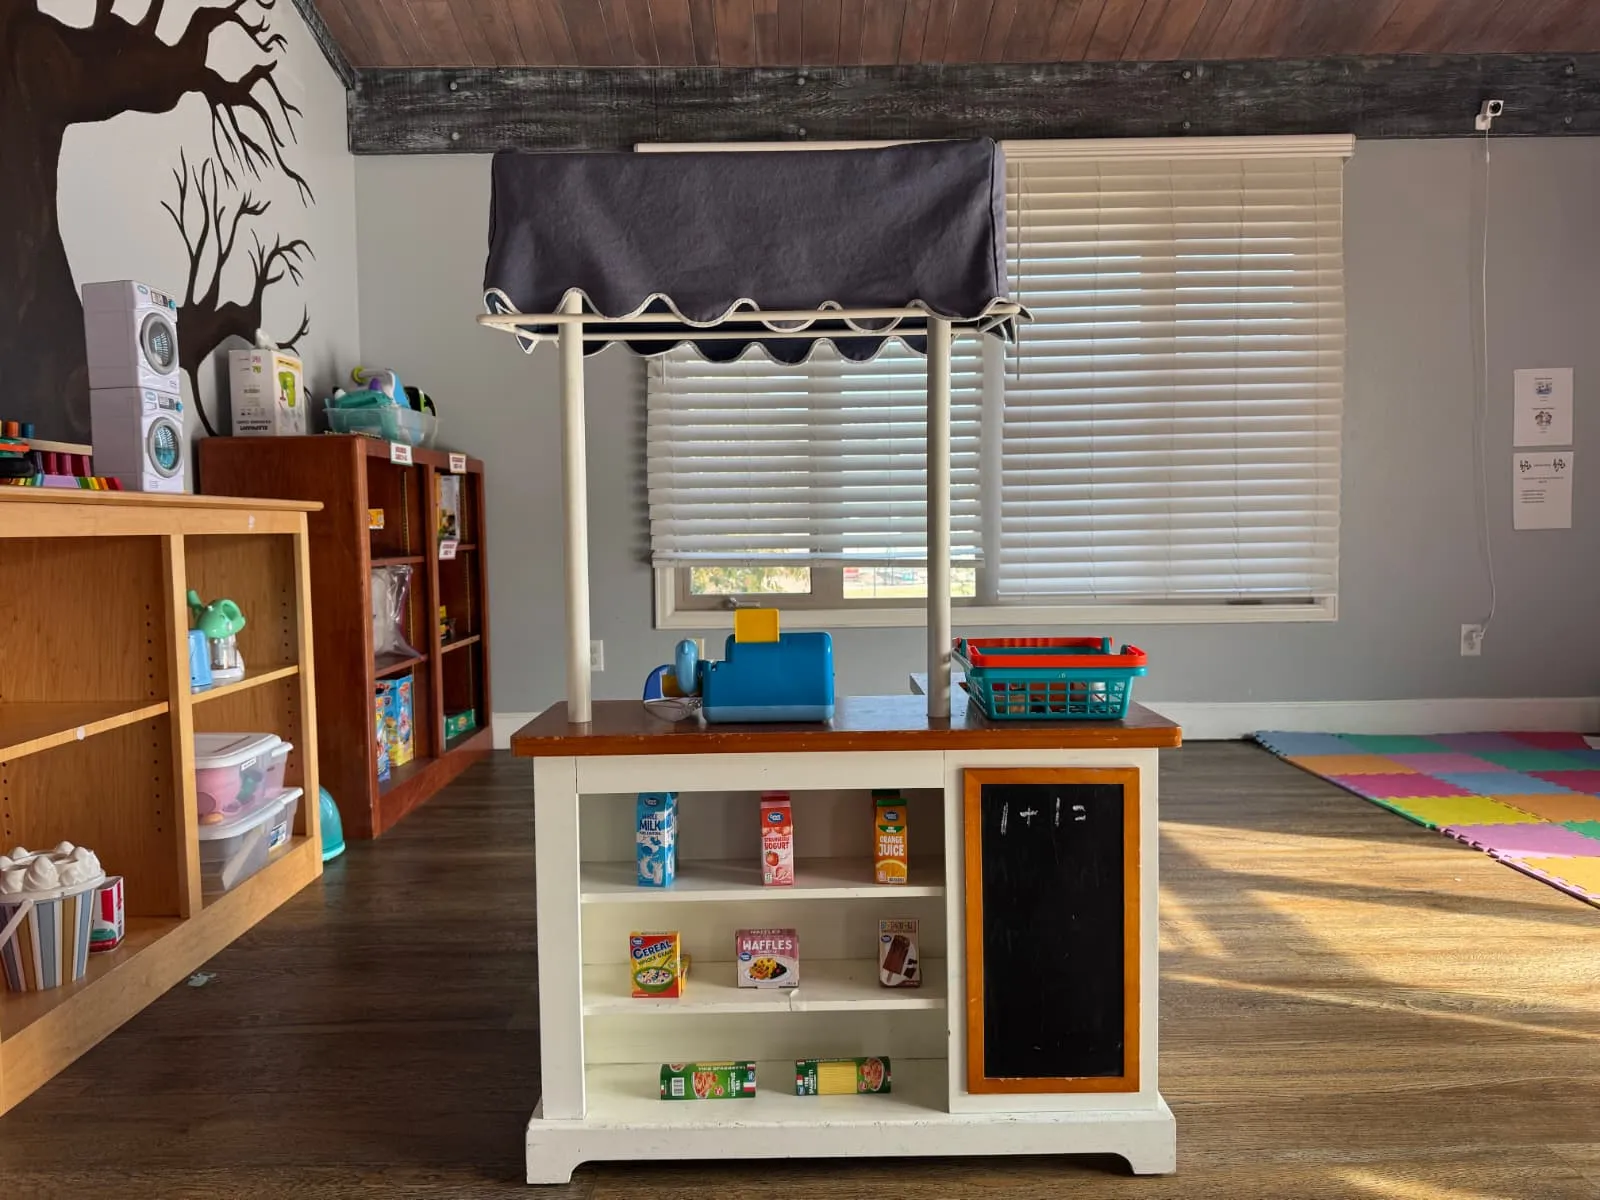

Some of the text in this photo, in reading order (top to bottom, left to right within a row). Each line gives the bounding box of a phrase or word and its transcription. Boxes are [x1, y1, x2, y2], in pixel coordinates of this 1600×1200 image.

[640, 820, 661, 831] MILK
[880, 836, 903, 844] ORANGE
[764, 842, 789, 850] YOGURT
[879, 844, 904, 857] JUICE
[633, 940, 672, 960] CEREAL
[743, 940, 793, 951] WAFFLES
